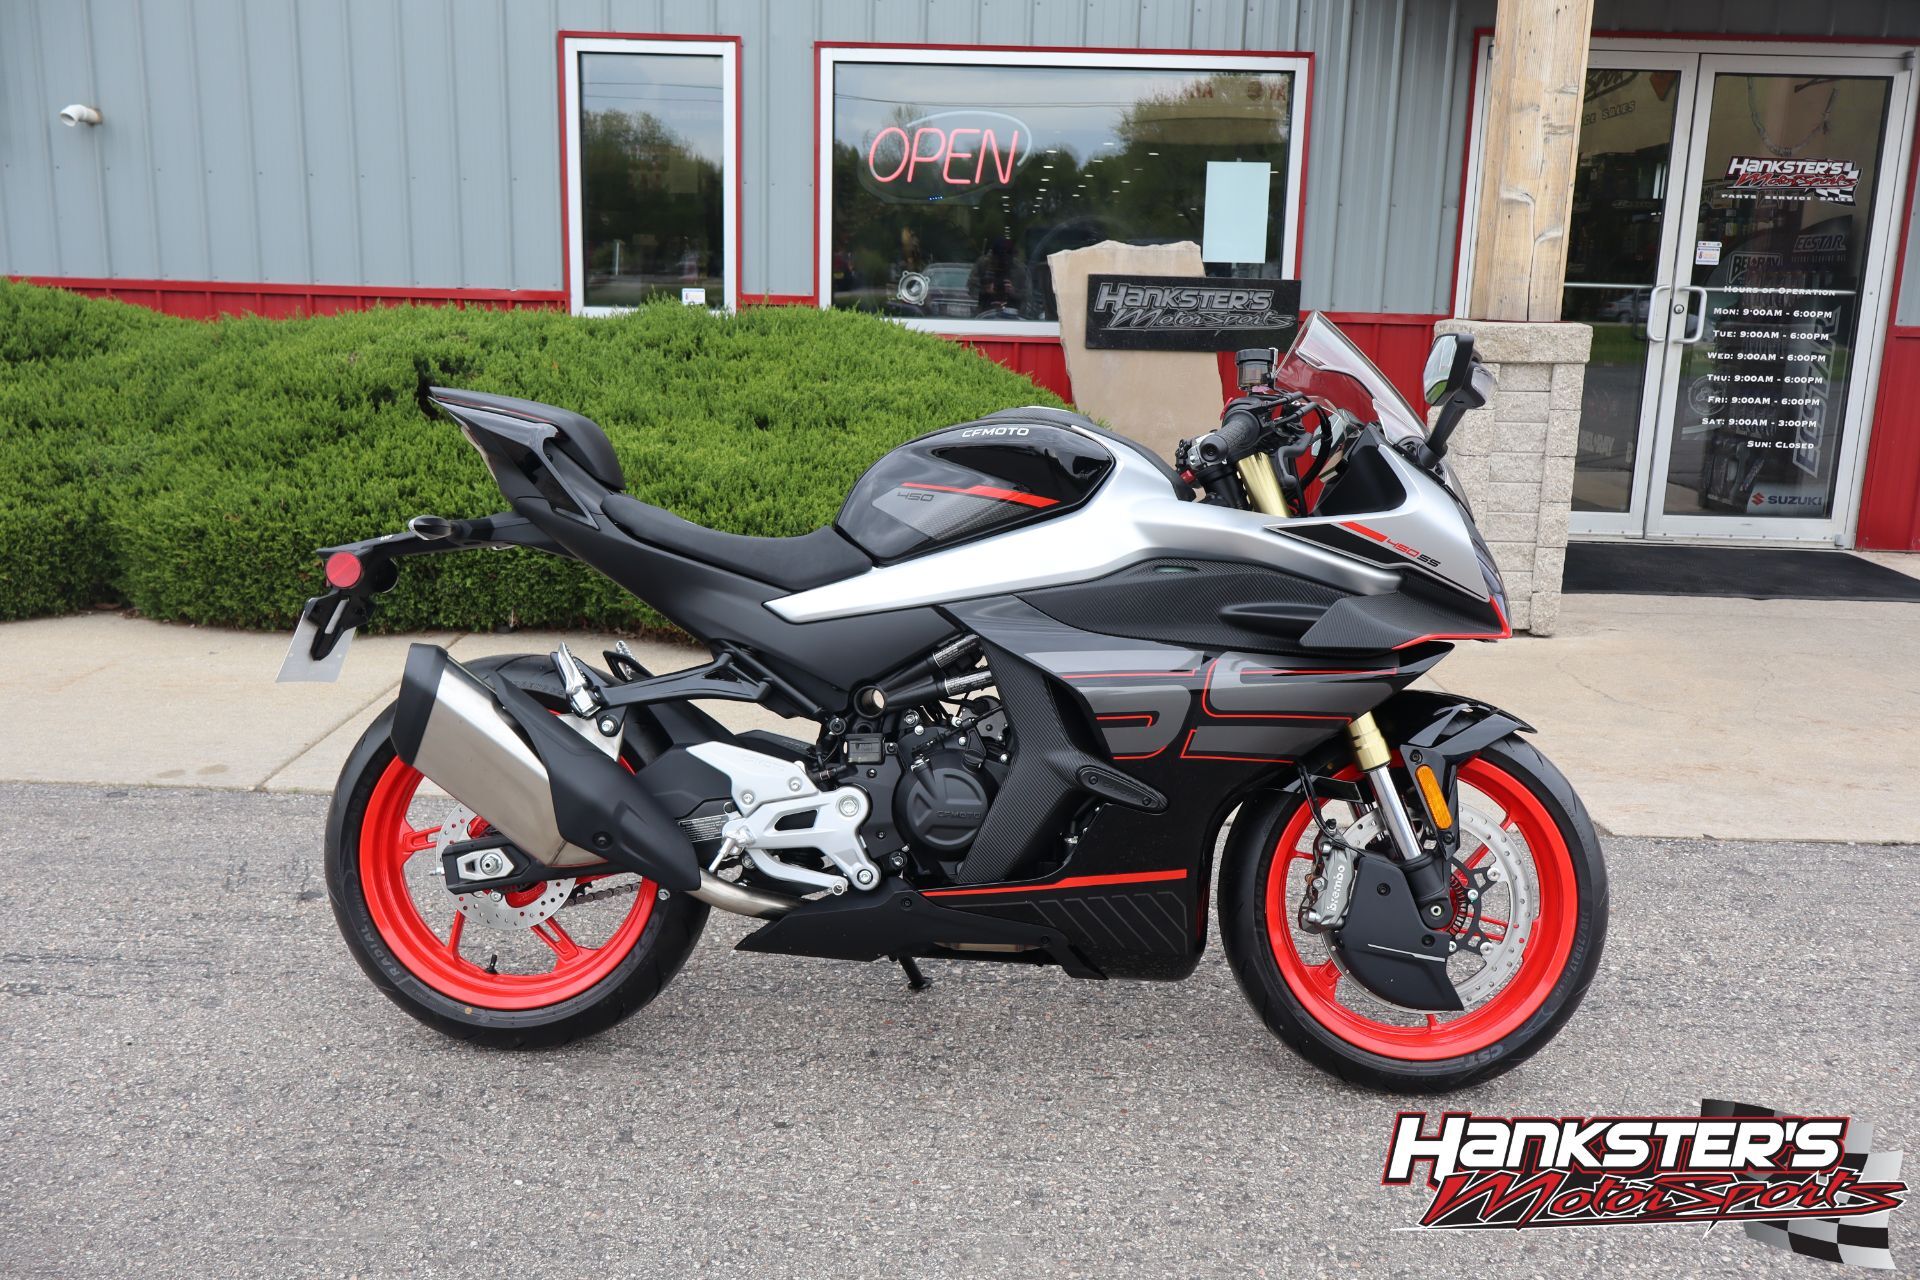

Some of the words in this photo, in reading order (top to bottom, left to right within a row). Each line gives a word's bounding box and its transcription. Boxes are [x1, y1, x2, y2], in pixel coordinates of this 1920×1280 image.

[868, 126, 1019, 185] OPEN
[1778, 288, 1835, 296] OPERATION
[1743, 308, 1782, 317] 9:00AM
[1793, 310, 1832, 319] 6:00PM
[1790, 332, 1829, 340] 6:00PM
[1737, 353, 1776, 361] 9:00AM
[1787, 354, 1826, 362] 6:00PM
[1734, 375, 1773, 383] 9:00AM
[1784, 376, 1823, 384] 6:00PM
[1732, 397, 1771, 405] 9:00AM
[1781, 398, 1820, 406] 6:00PM
[1778, 420, 1817, 428] 3:00PM
[961, 427, 1030, 438] CFMOTO
[1775, 441, 1814, 449] CLOSED
[897, 491, 934, 502] 450
[1767, 495, 1822, 506] SUZUKI
[1327, 864, 1345, 914] brembo
[358, 924, 402, 981] RADIAL
[1463, 1043, 1505, 1068] CST
